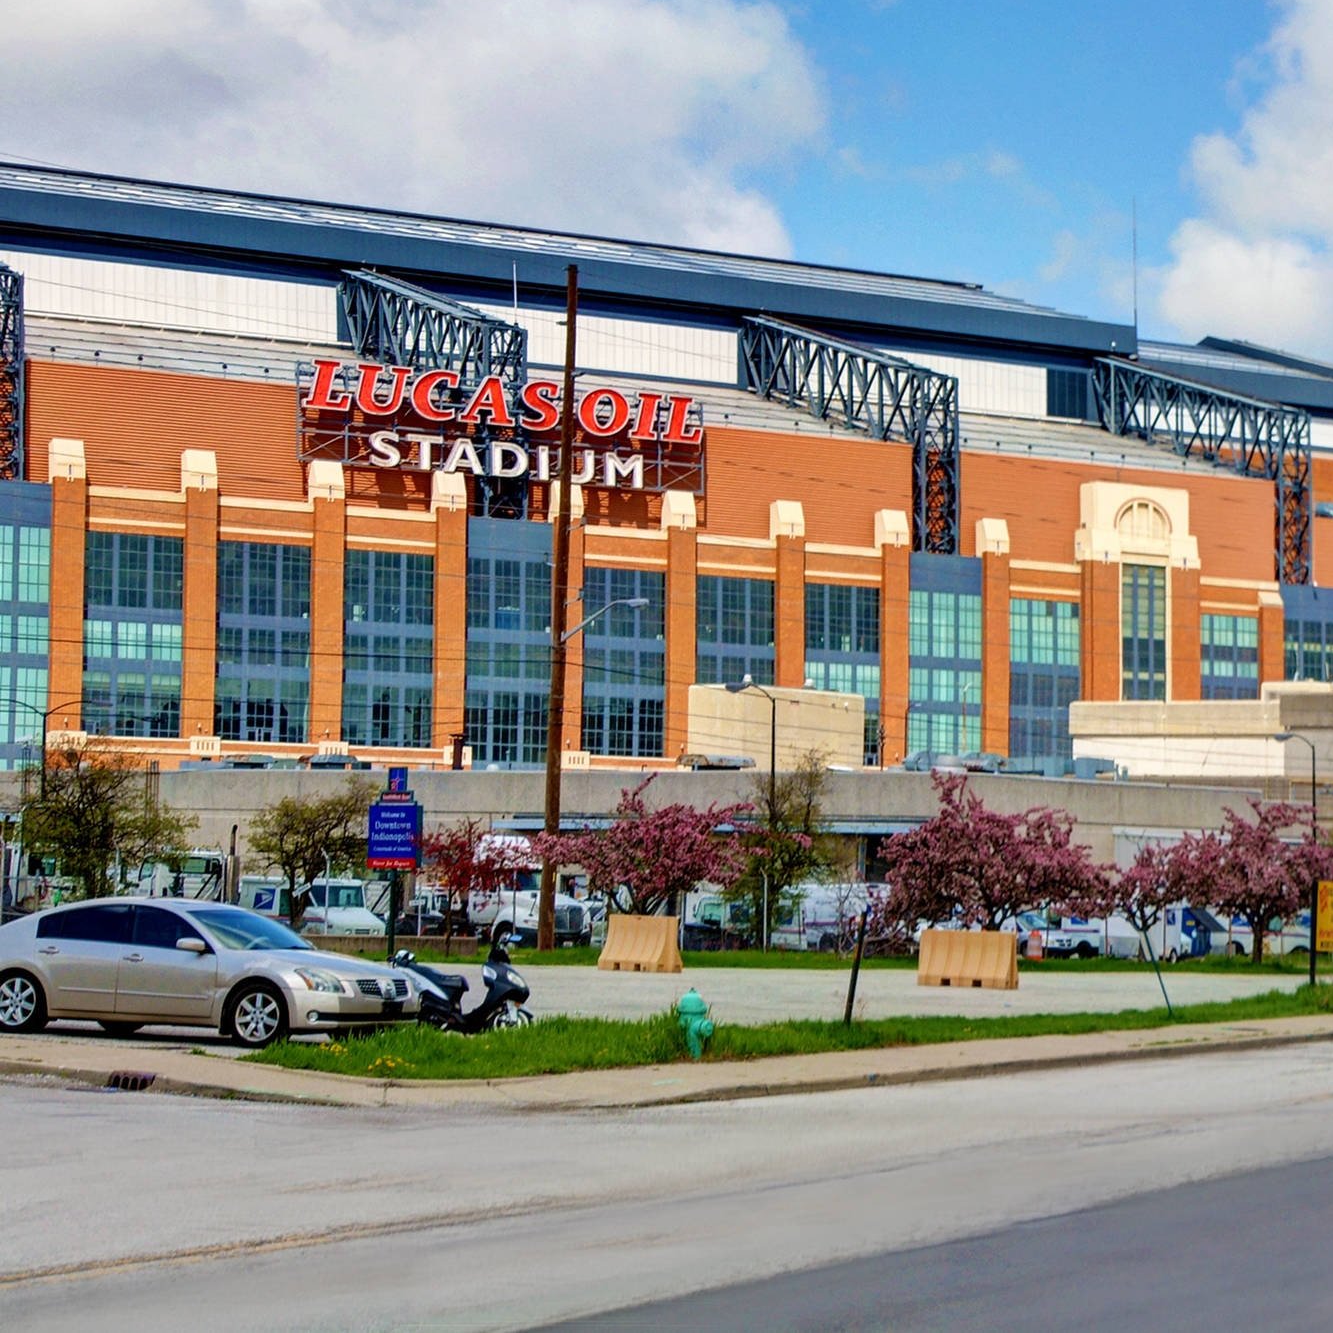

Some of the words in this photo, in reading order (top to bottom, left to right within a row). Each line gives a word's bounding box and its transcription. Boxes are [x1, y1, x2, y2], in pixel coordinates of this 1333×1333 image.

[302, 358, 560, 432] LUCAS
[577, 388, 703, 444] OIL
[369, 429, 645, 489] STADIUM
[371, 832, 414, 842] Indianapolis
[375, 821, 411, 830] Downtown
